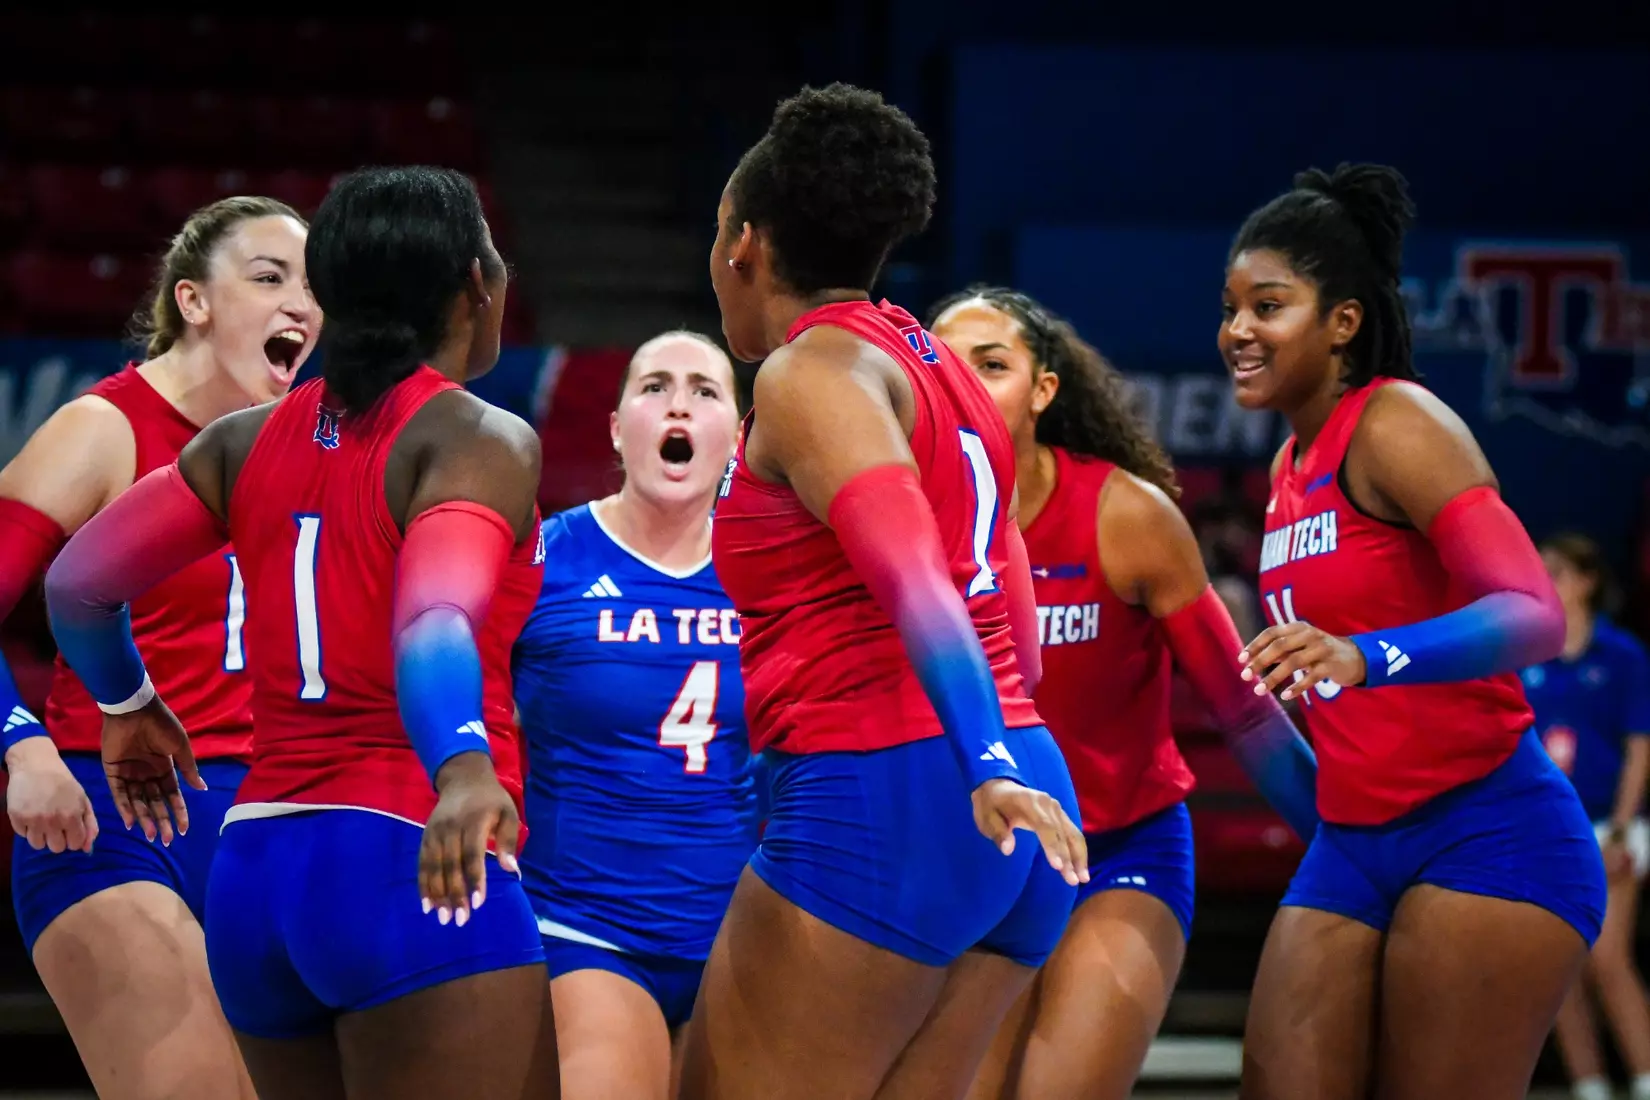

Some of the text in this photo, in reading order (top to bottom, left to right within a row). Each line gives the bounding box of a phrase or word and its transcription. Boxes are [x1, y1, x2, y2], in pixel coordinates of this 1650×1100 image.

[958, 426, 998, 597] 1
[1290, 510, 1338, 562] TECH
[293, 513, 328, 702] 1
[597, 608, 661, 643] LA
[1036, 603, 1101, 646] TECH
[657, 660, 722, 776] 4
